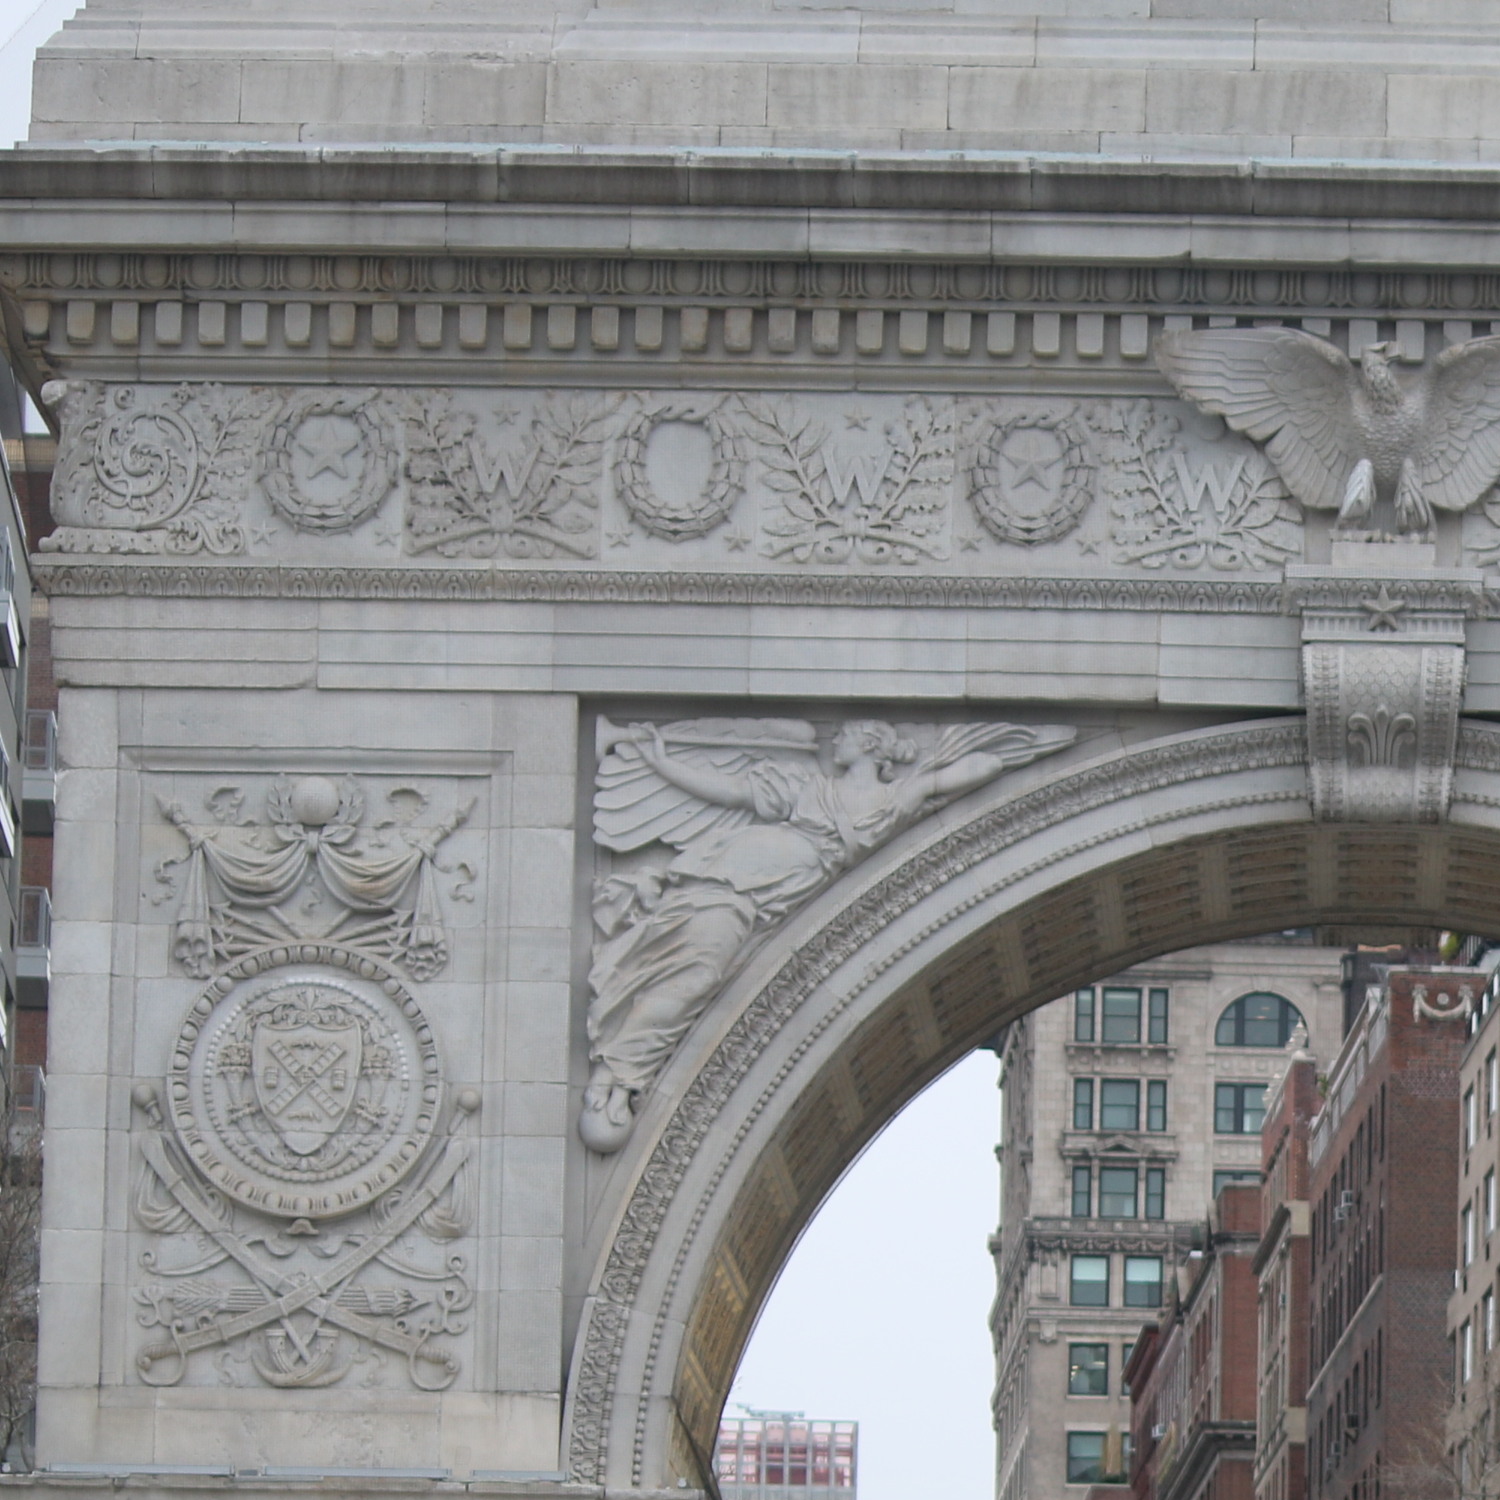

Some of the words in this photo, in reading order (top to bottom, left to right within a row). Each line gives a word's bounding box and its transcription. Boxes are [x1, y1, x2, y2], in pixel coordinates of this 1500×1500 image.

[469, 440, 542, 498] W
[820, 447, 892, 505] W
[1172, 452, 1248, 511] W
